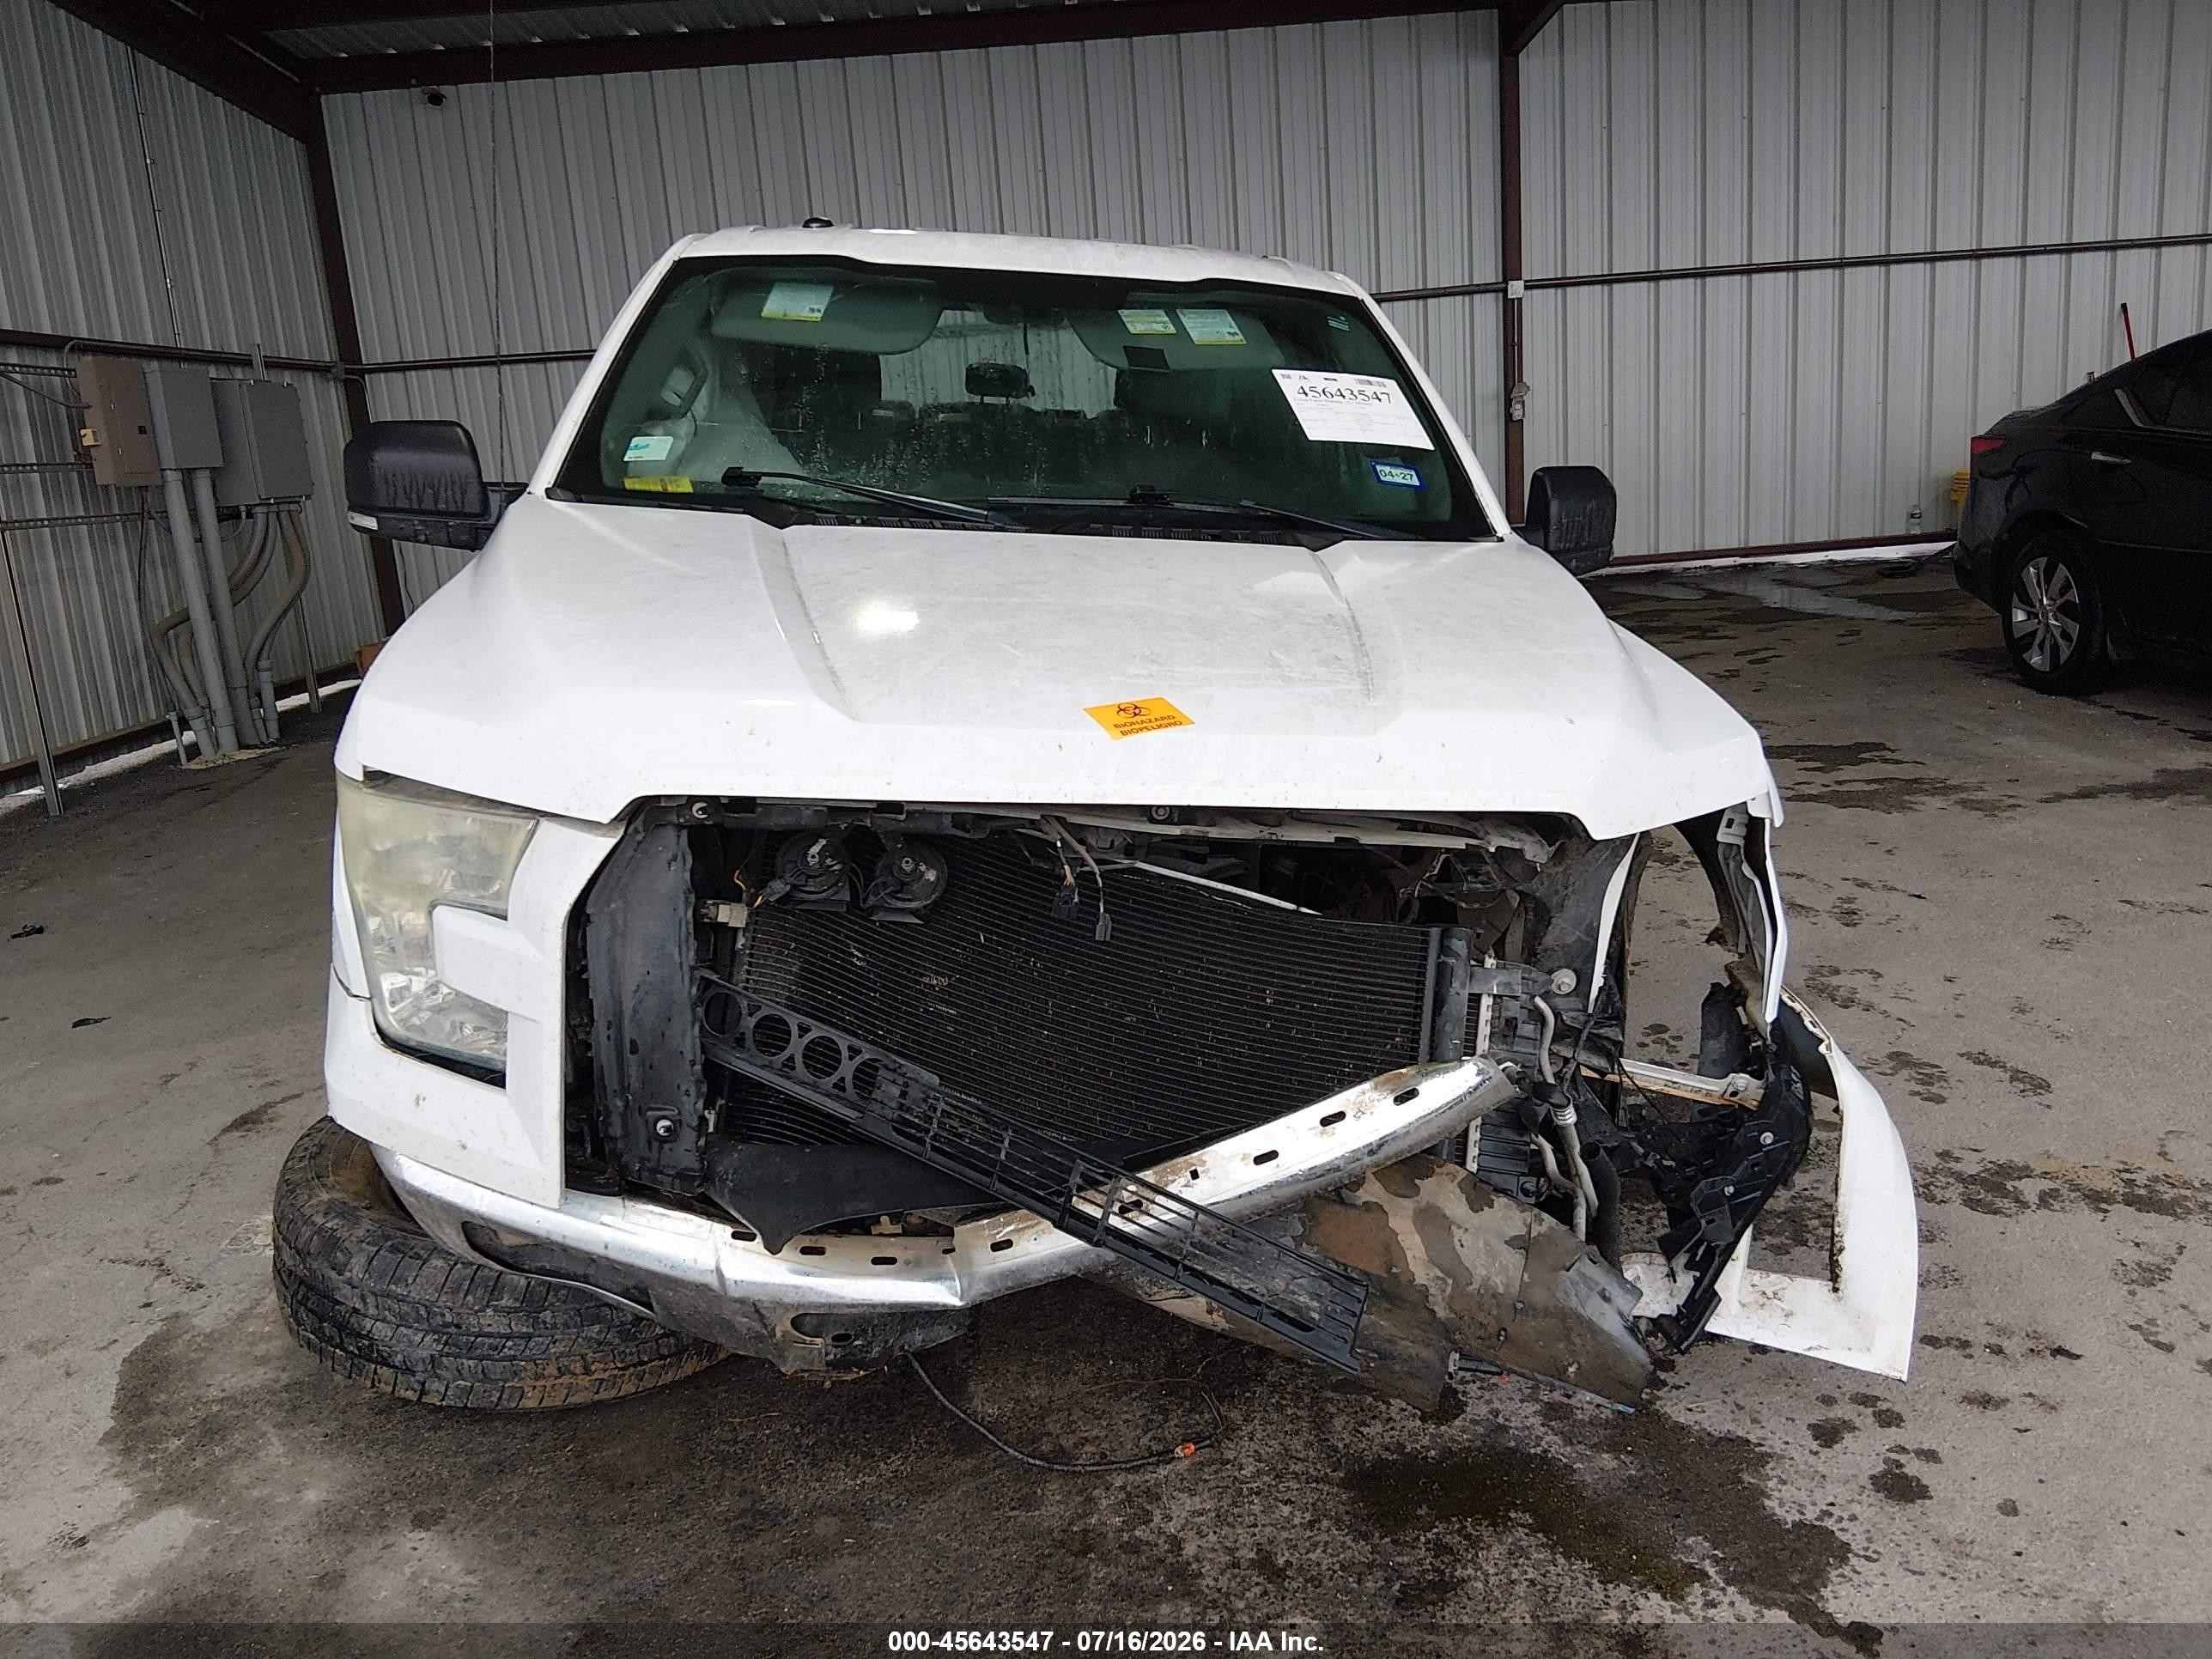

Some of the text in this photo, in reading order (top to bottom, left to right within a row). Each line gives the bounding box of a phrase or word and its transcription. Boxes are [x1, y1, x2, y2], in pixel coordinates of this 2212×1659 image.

[1297, 385, 1392, 404] 45643547
[1113, 714, 1176, 729] BIOHAZARD
[1120, 720, 1182, 736] BIOPELIGRO
